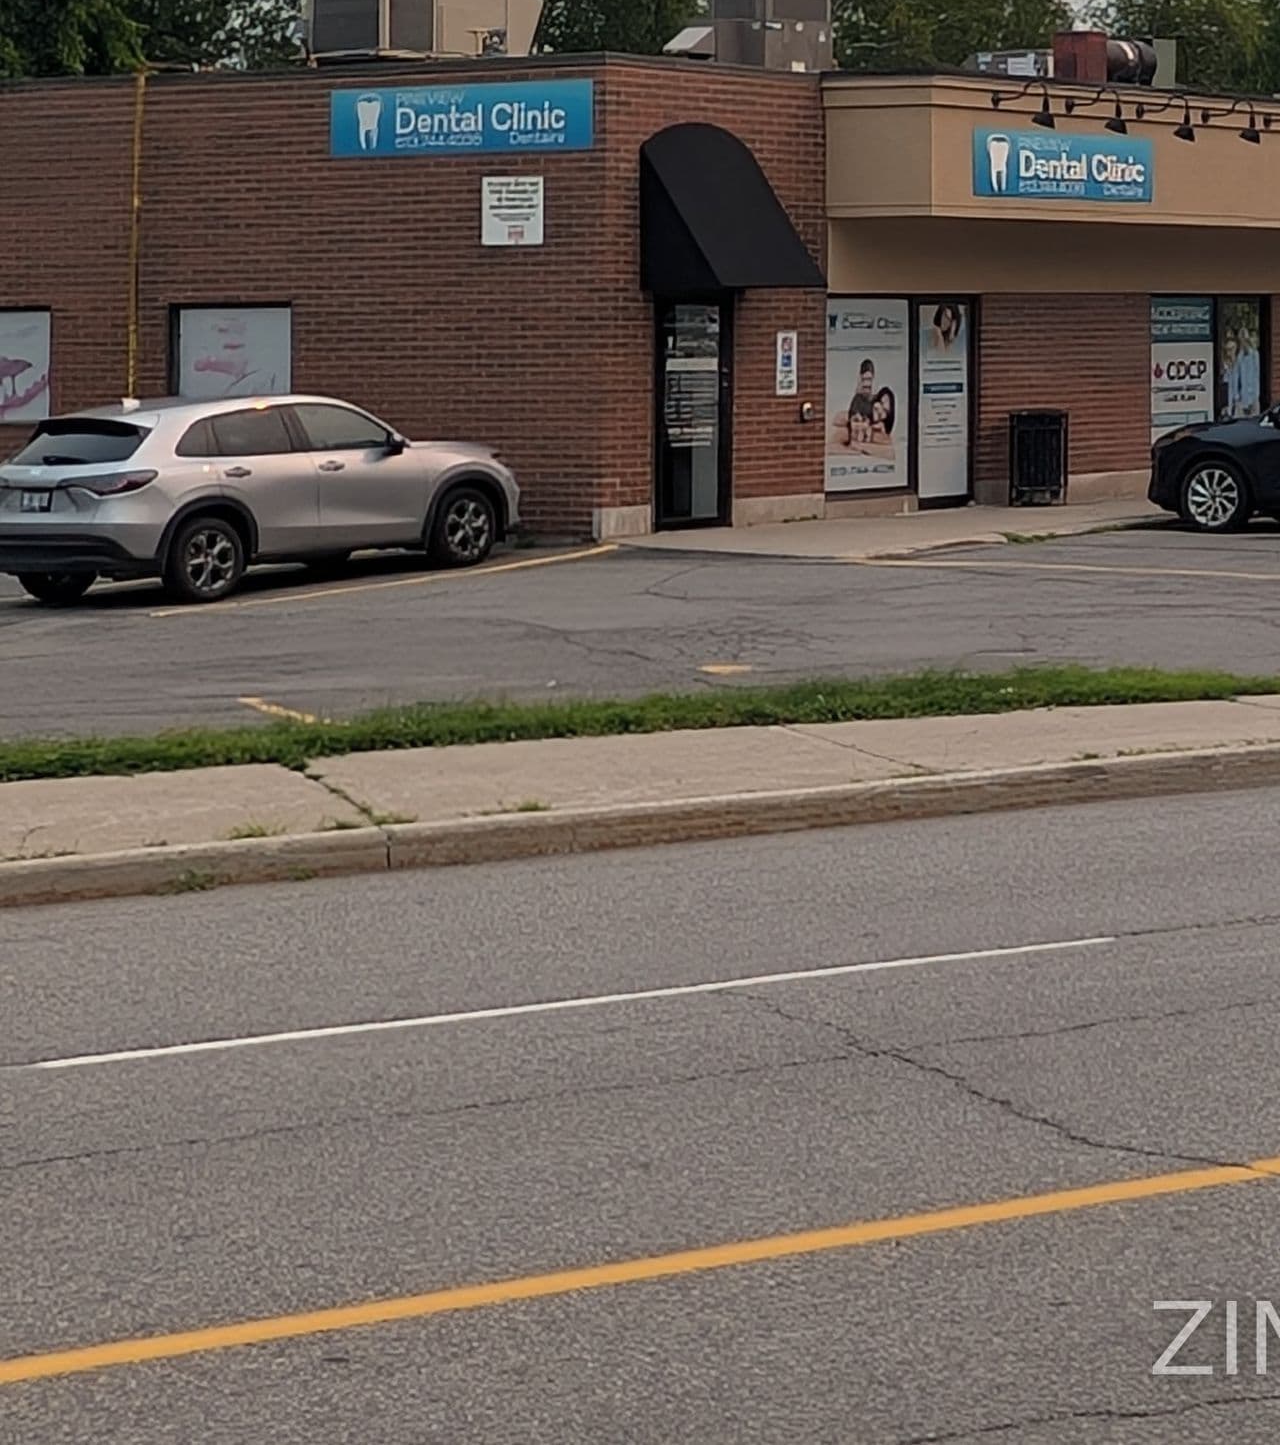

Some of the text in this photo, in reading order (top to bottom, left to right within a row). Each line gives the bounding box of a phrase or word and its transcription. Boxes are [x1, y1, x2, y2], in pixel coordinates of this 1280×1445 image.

[395, 101, 566, 135] Dental Clinic
[1018, 149, 1146, 183] Dental Clinic
[1166, 359, 1208, 381] CDCP
